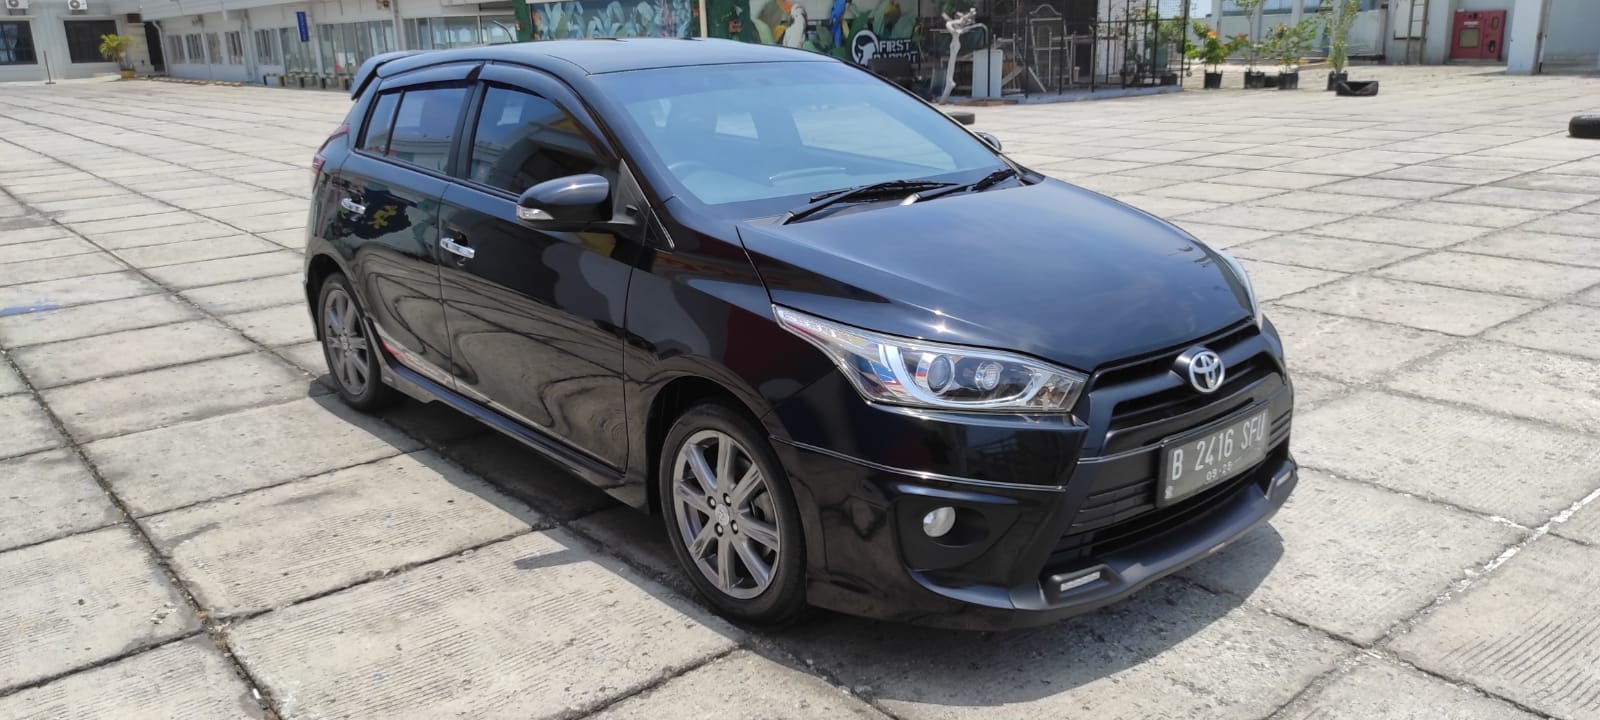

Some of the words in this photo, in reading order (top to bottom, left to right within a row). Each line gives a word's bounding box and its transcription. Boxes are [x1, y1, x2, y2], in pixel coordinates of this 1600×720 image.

[880, 39, 911, 52] FIRST
[1172, 449, 1183, 480] B
[1195, 429, 1234, 471] 2416
[1241, 412, 1266, 449] SFU
